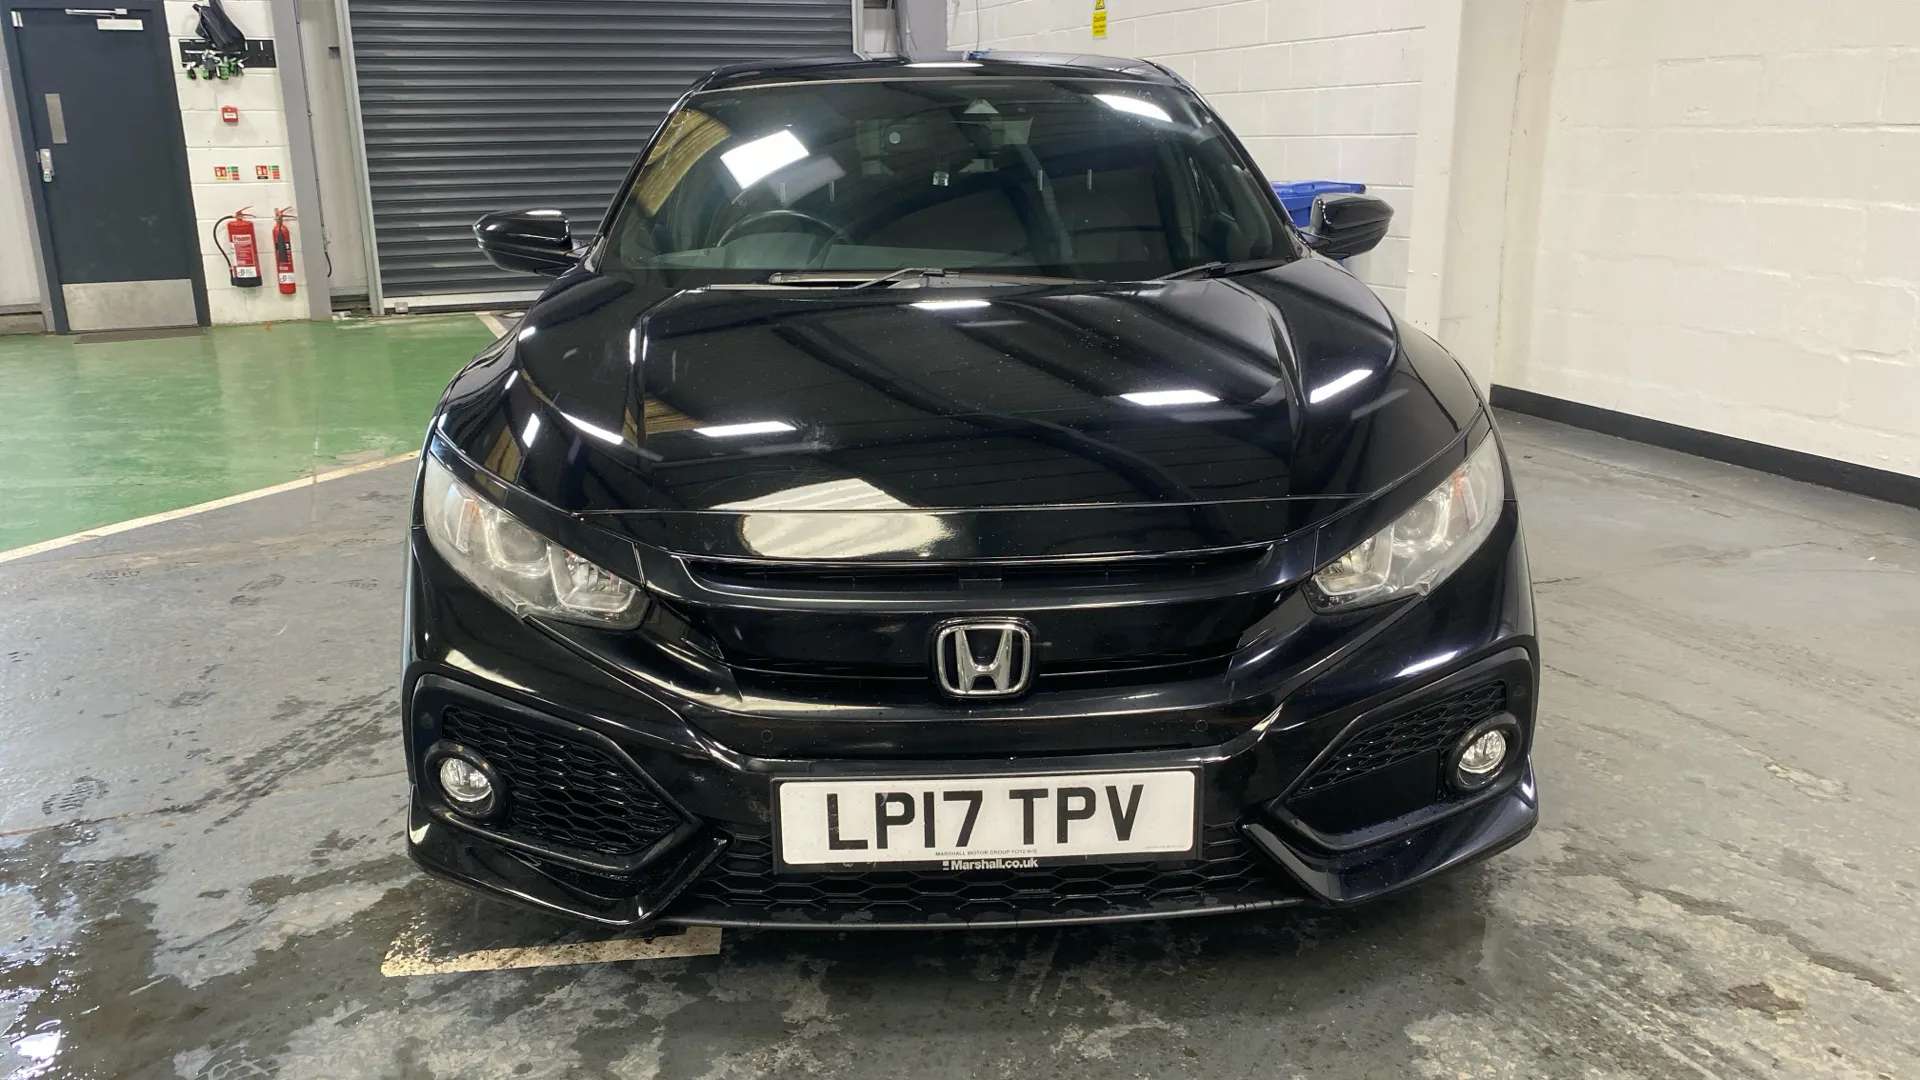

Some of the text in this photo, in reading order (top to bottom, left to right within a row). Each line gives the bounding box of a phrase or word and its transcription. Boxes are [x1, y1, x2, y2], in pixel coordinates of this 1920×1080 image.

[826, 784, 1145, 851] LP17 TPV
[950, 858, 1040, 871] Marshall.co.uk
